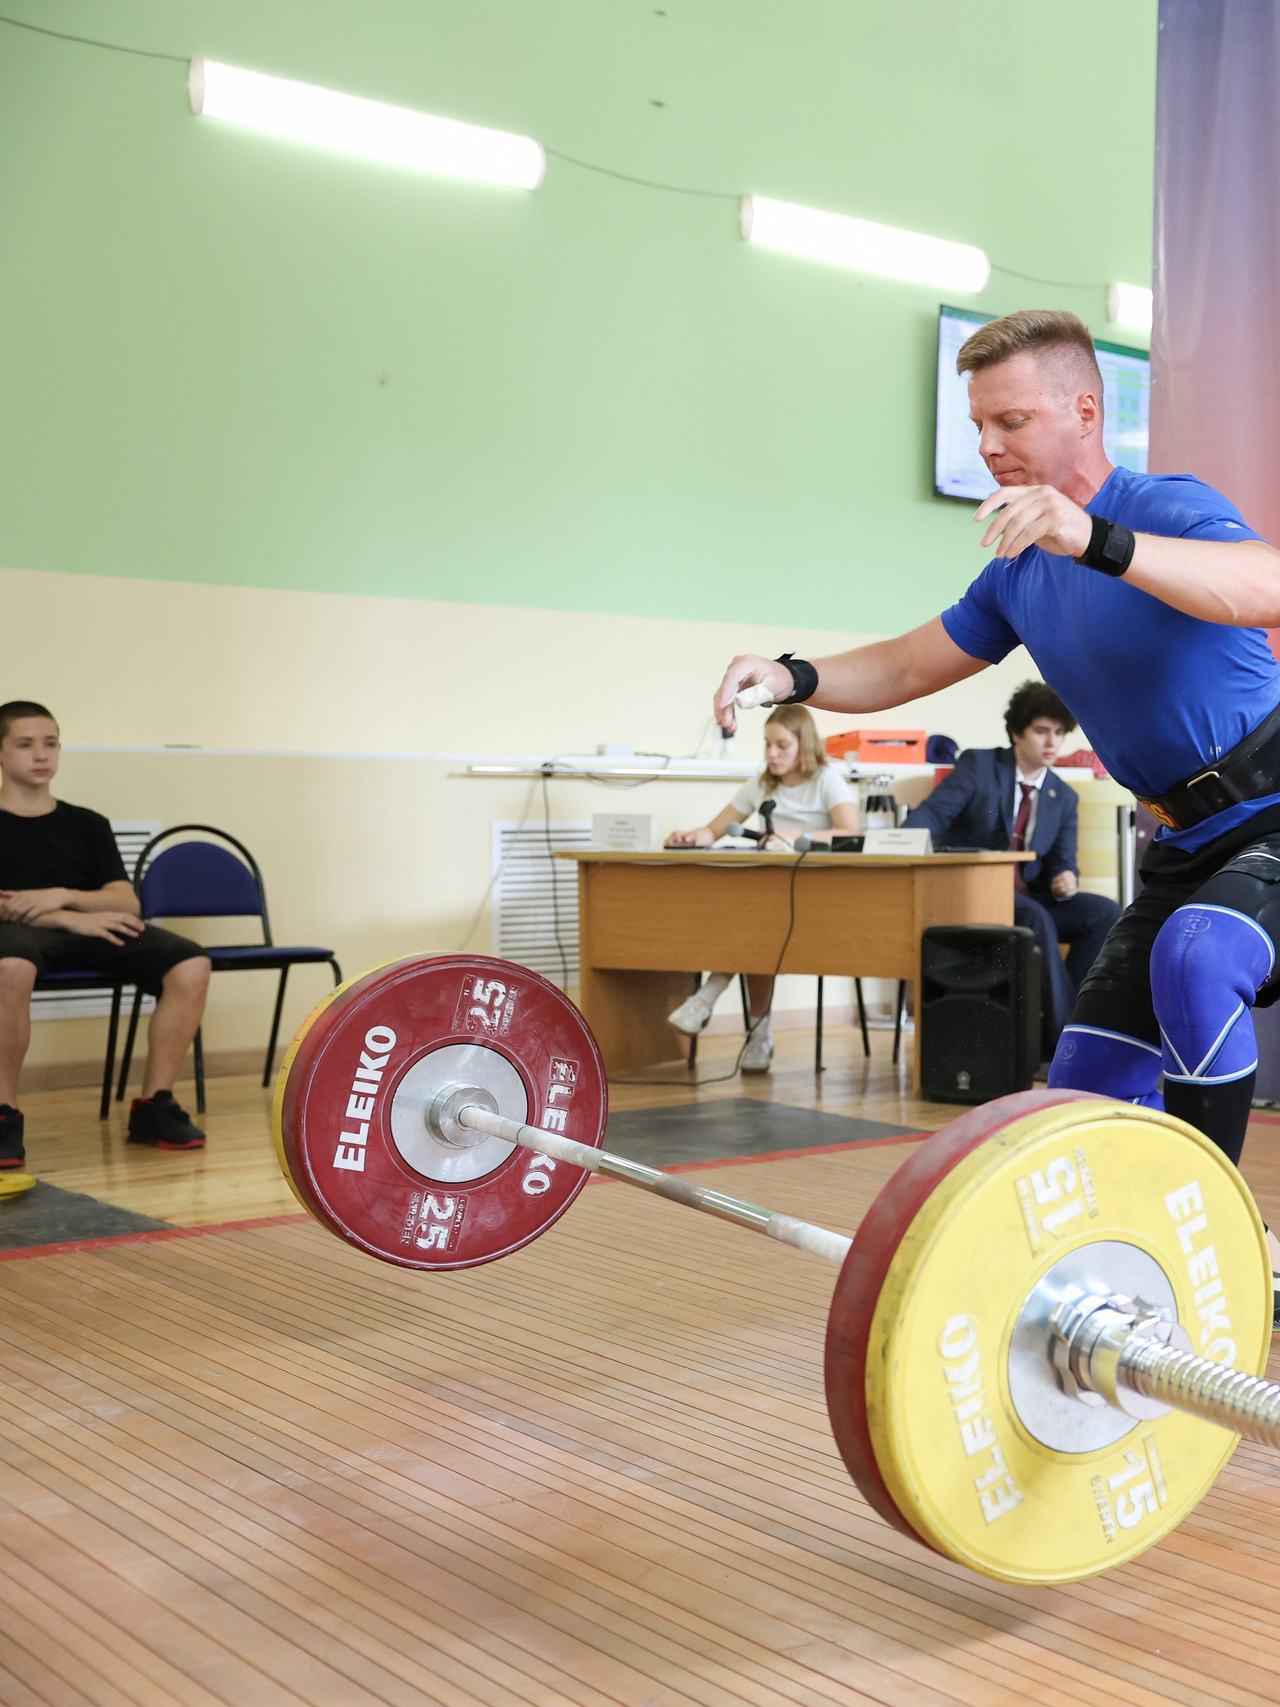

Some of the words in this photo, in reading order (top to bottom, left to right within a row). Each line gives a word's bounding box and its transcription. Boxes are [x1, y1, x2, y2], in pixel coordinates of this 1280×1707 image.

[465, 977, 507, 1037] 25
[332, 1025, 397, 1172] ELEIKO
[521, 1056, 580, 1197] ELEKO
[414, 1190, 455, 1250] 25
[1029, 1155, 1084, 1241] 15
[936, 1312, 1026, 1526] ELEIKO
[1107, 1450, 1158, 1530] 15
